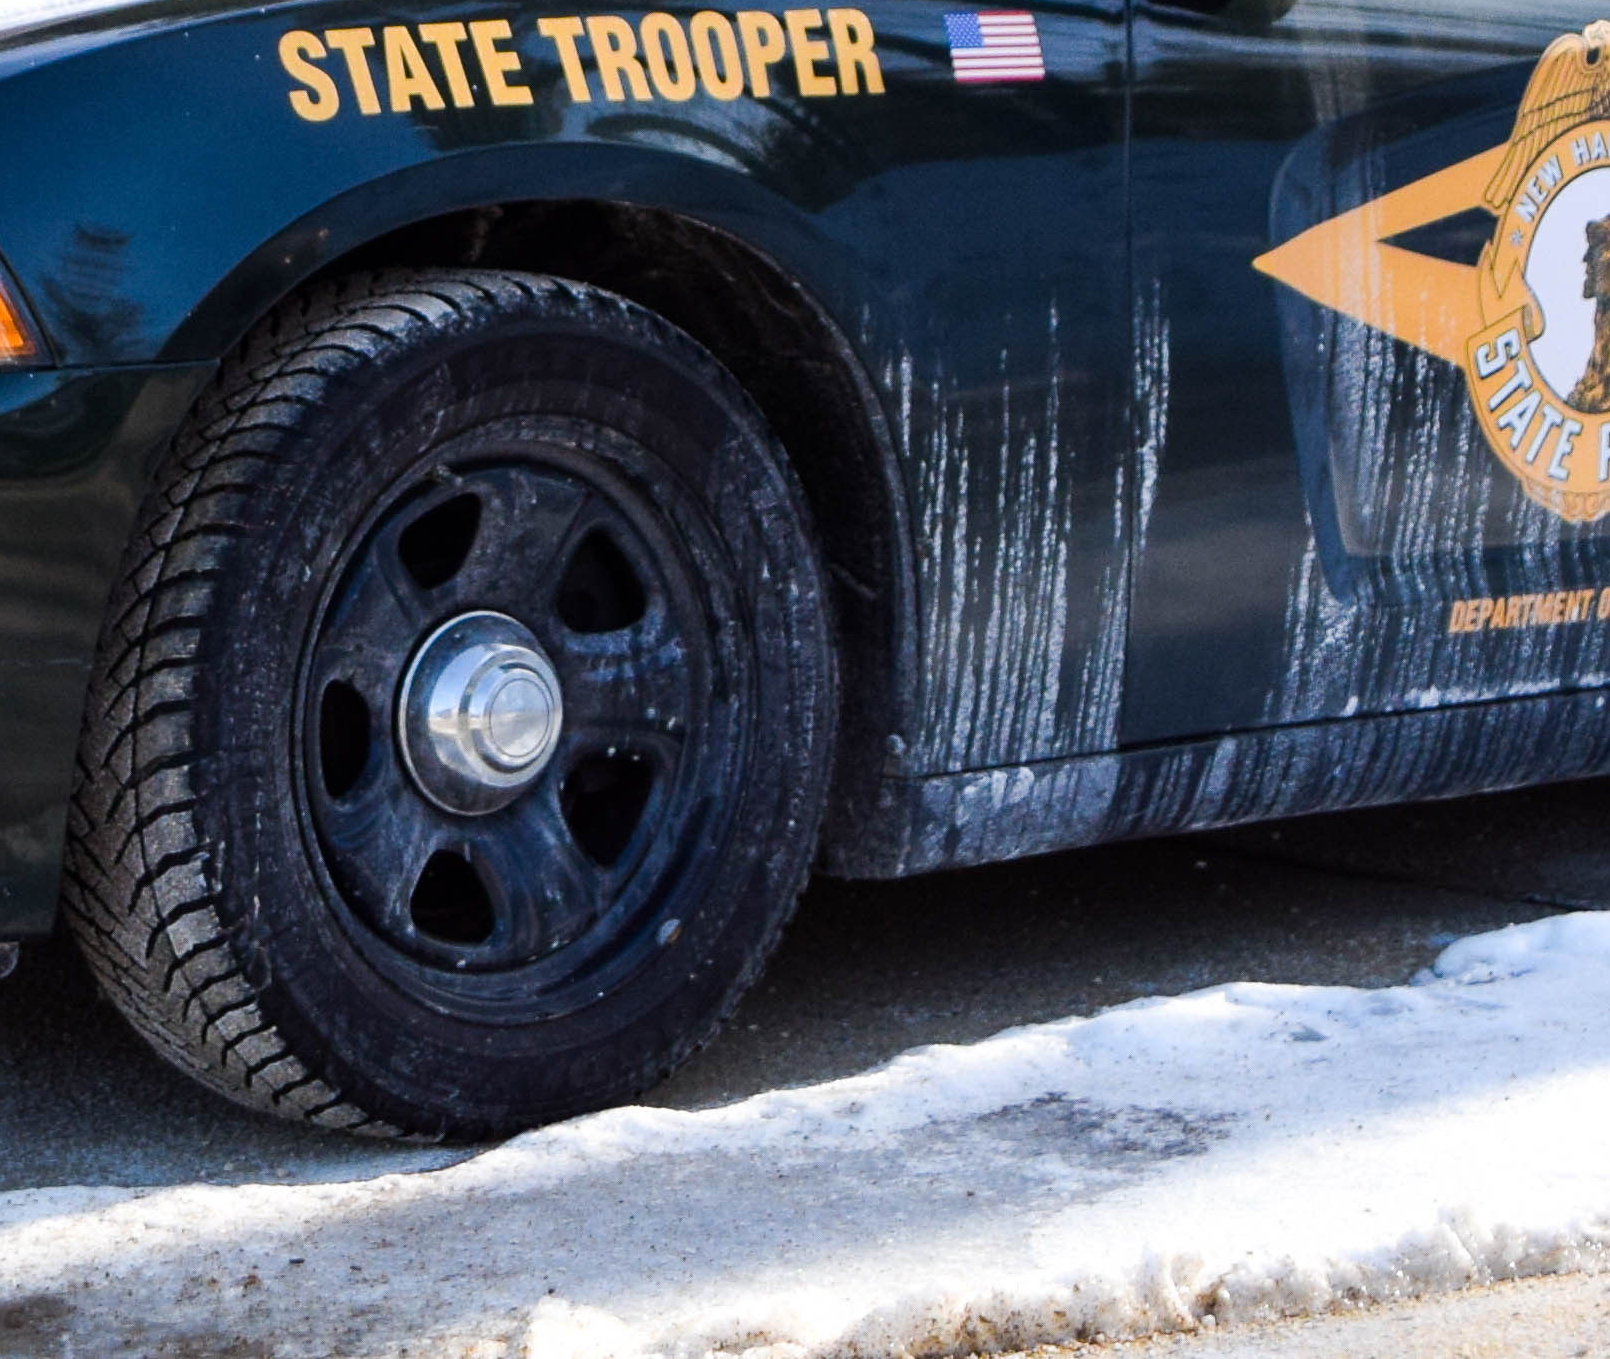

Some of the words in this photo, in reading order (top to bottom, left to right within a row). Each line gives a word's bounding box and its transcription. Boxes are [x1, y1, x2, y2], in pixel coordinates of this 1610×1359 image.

[278, 19, 533, 123] STATE
[537, 8, 886, 104] TROOPER
[1515, 153, 1564, 224] NEW
[1474, 326, 1584, 482] STATE
[1447, 588, 1595, 634] DEPARTMENT
